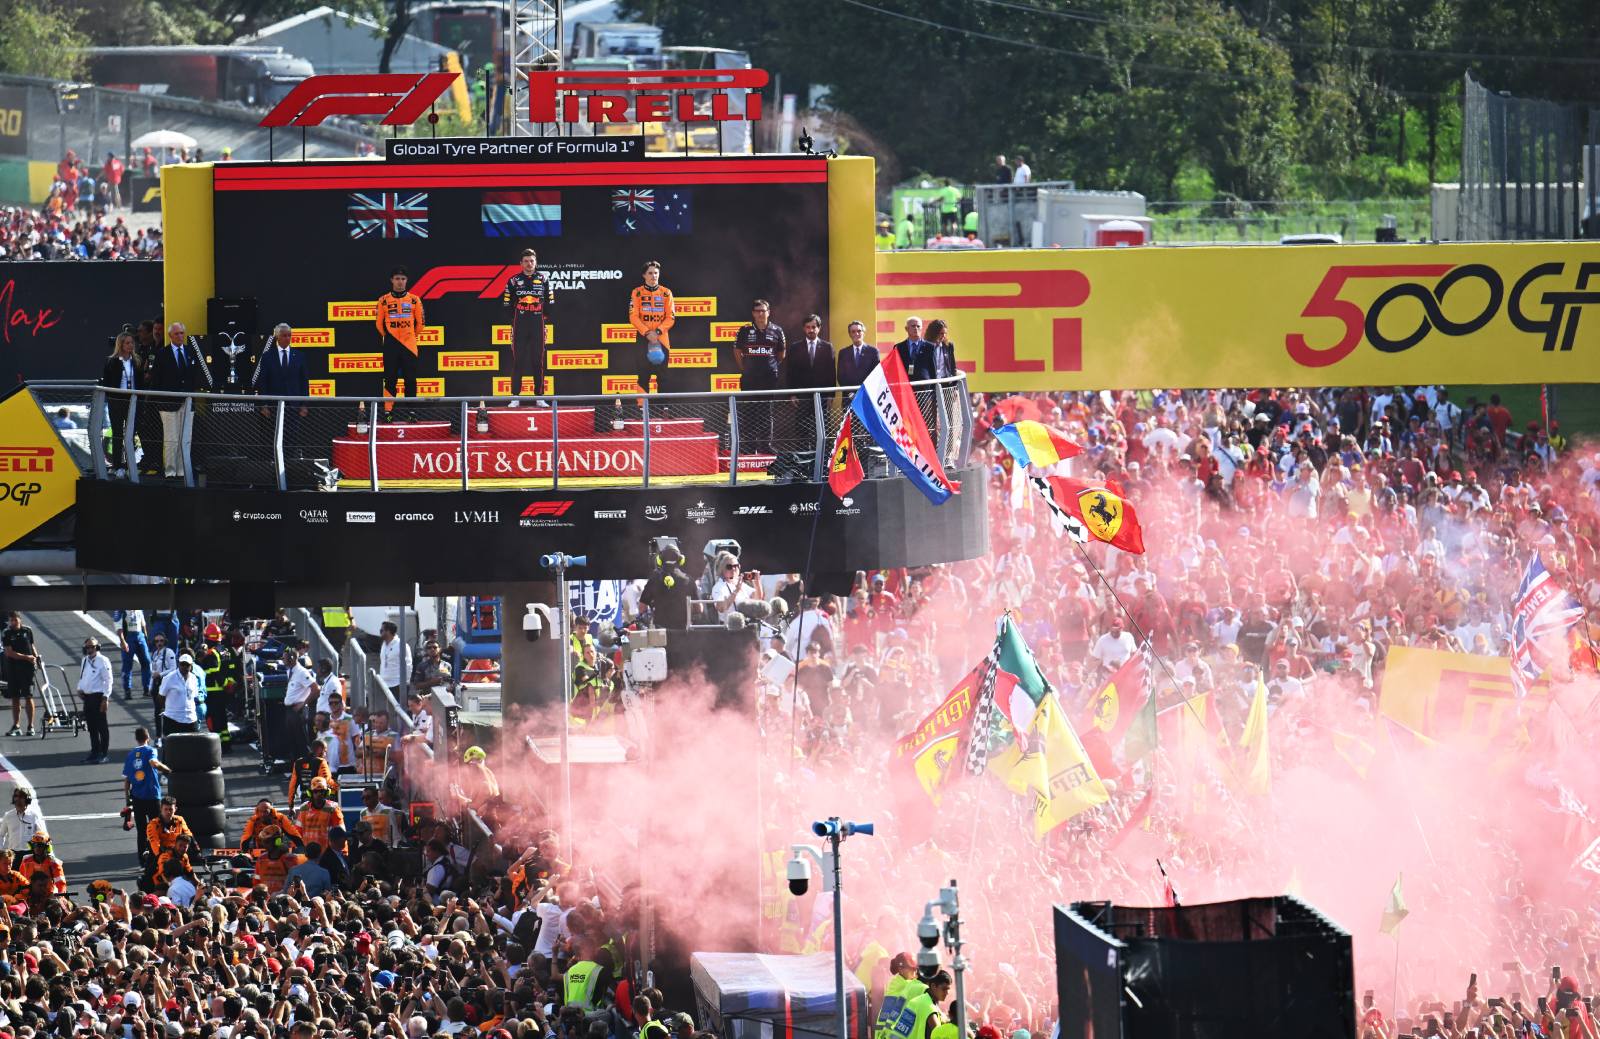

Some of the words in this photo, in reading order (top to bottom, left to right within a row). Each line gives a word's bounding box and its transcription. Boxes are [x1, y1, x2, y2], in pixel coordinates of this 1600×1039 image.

[529, 69, 770, 123] PIRELLI
[393, 143, 440, 156] Global
[443, 142, 476, 157] Tyre
[480, 141, 534, 155] Partner
[538, 141, 553, 154] of
[557, 140, 618, 154] Formula
[572, 270, 623, 280] PREMIO
[443, 354, 494, 367] PIRELLI
[552, 353, 604, 366] PIRELLI
[528, 416, 538, 431] 1
[398, 429, 405, 438] 2
[655, 425, 662, 433] 3
[494, 451, 513, 472] &
[645, 505, 667, 514] aws
[738, 506, 769, 514] DHL
[799, 502, 821, 511] MSC
[243, 512, 282, 521] crypto.com
[299, 509, 328, 519] QATAR
[347, 512, 375, 521] Lenovo
[394, 512, 434, 521] aramco
[454, 511, 500, 523] LVMH
[594, 510, 627, 518] PIRELLI
